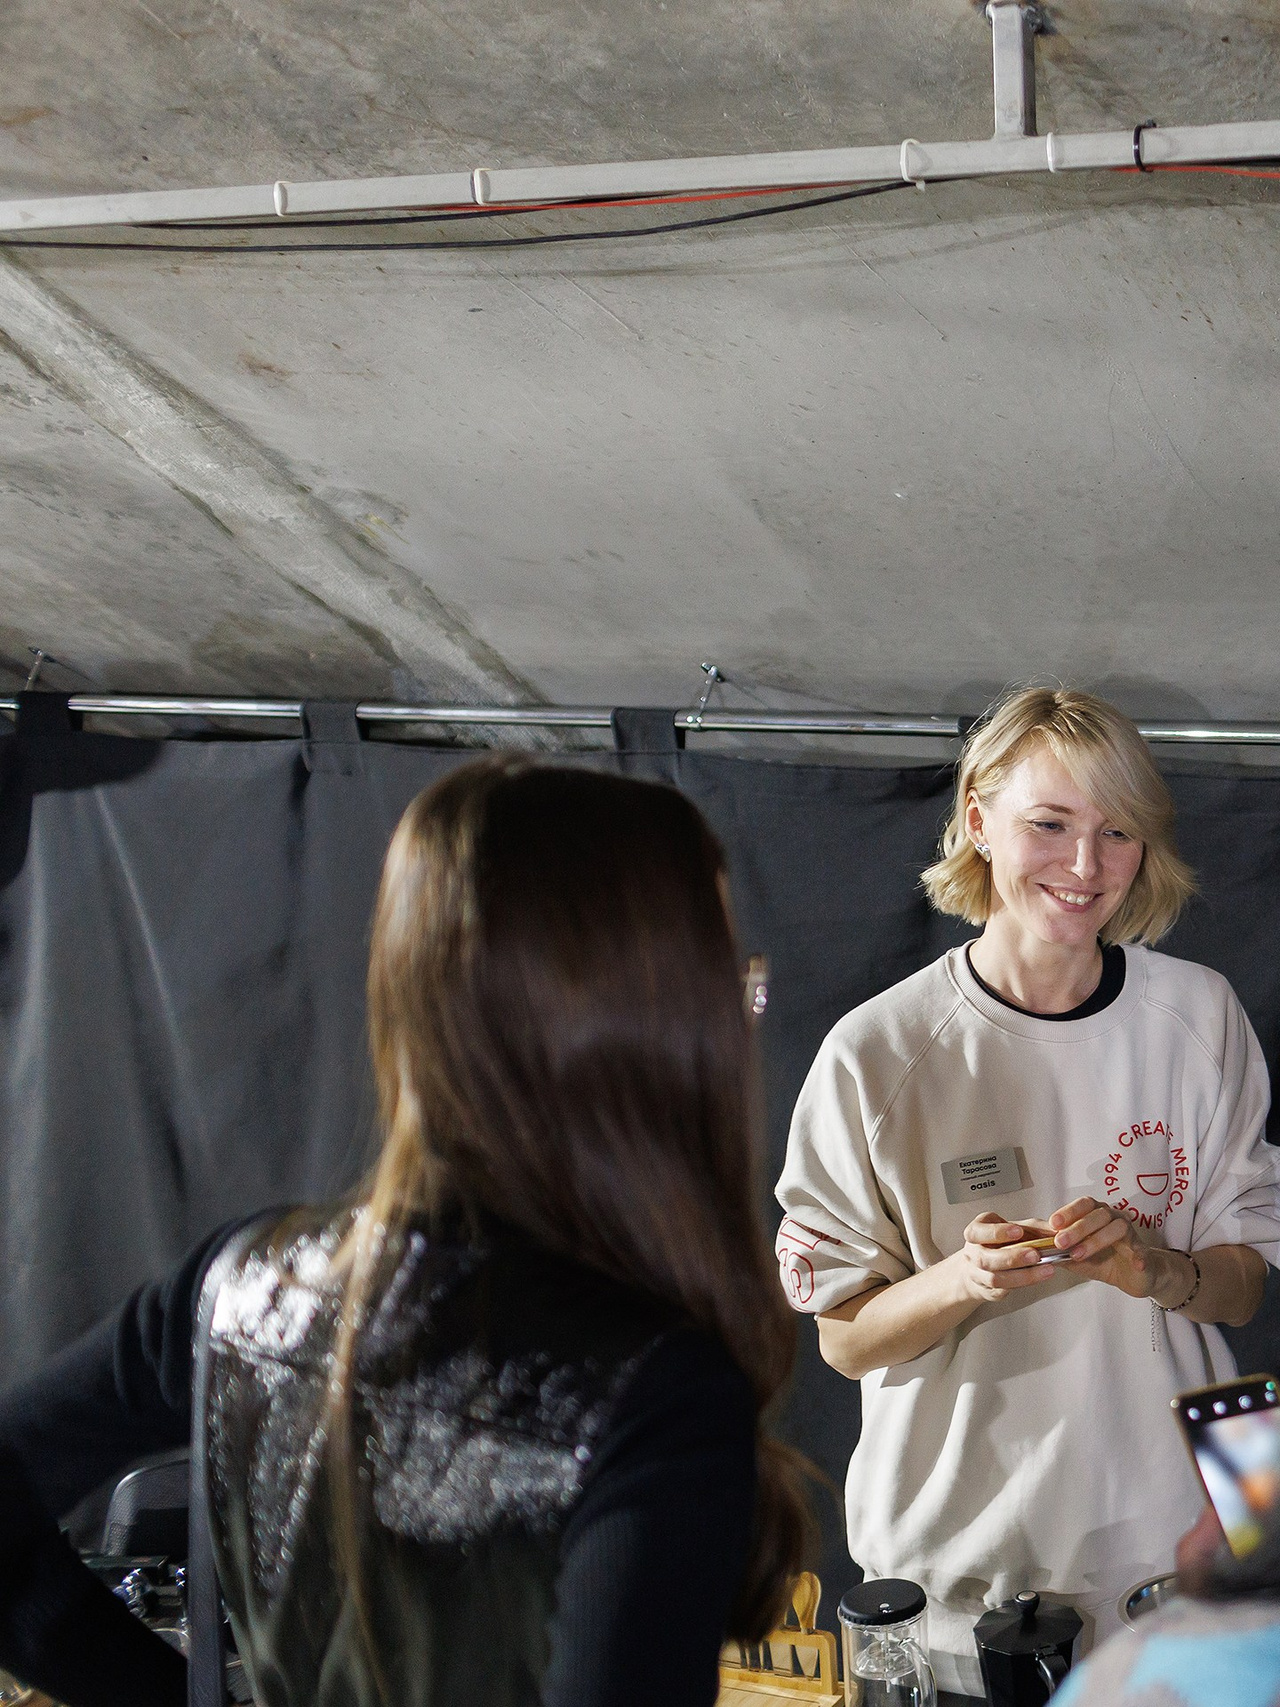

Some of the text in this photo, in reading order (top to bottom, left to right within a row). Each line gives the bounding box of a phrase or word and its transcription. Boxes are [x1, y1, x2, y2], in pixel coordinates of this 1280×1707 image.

[959, 1155, 997, 1168] Екатерина
[961, 1163, 997, 1174] Тарасова
[1104, 1152, 1123, 1196] 1994
[970, 1179, 996, 1191] oasis
[1113, 1197, 1163, 1229] SINCE
